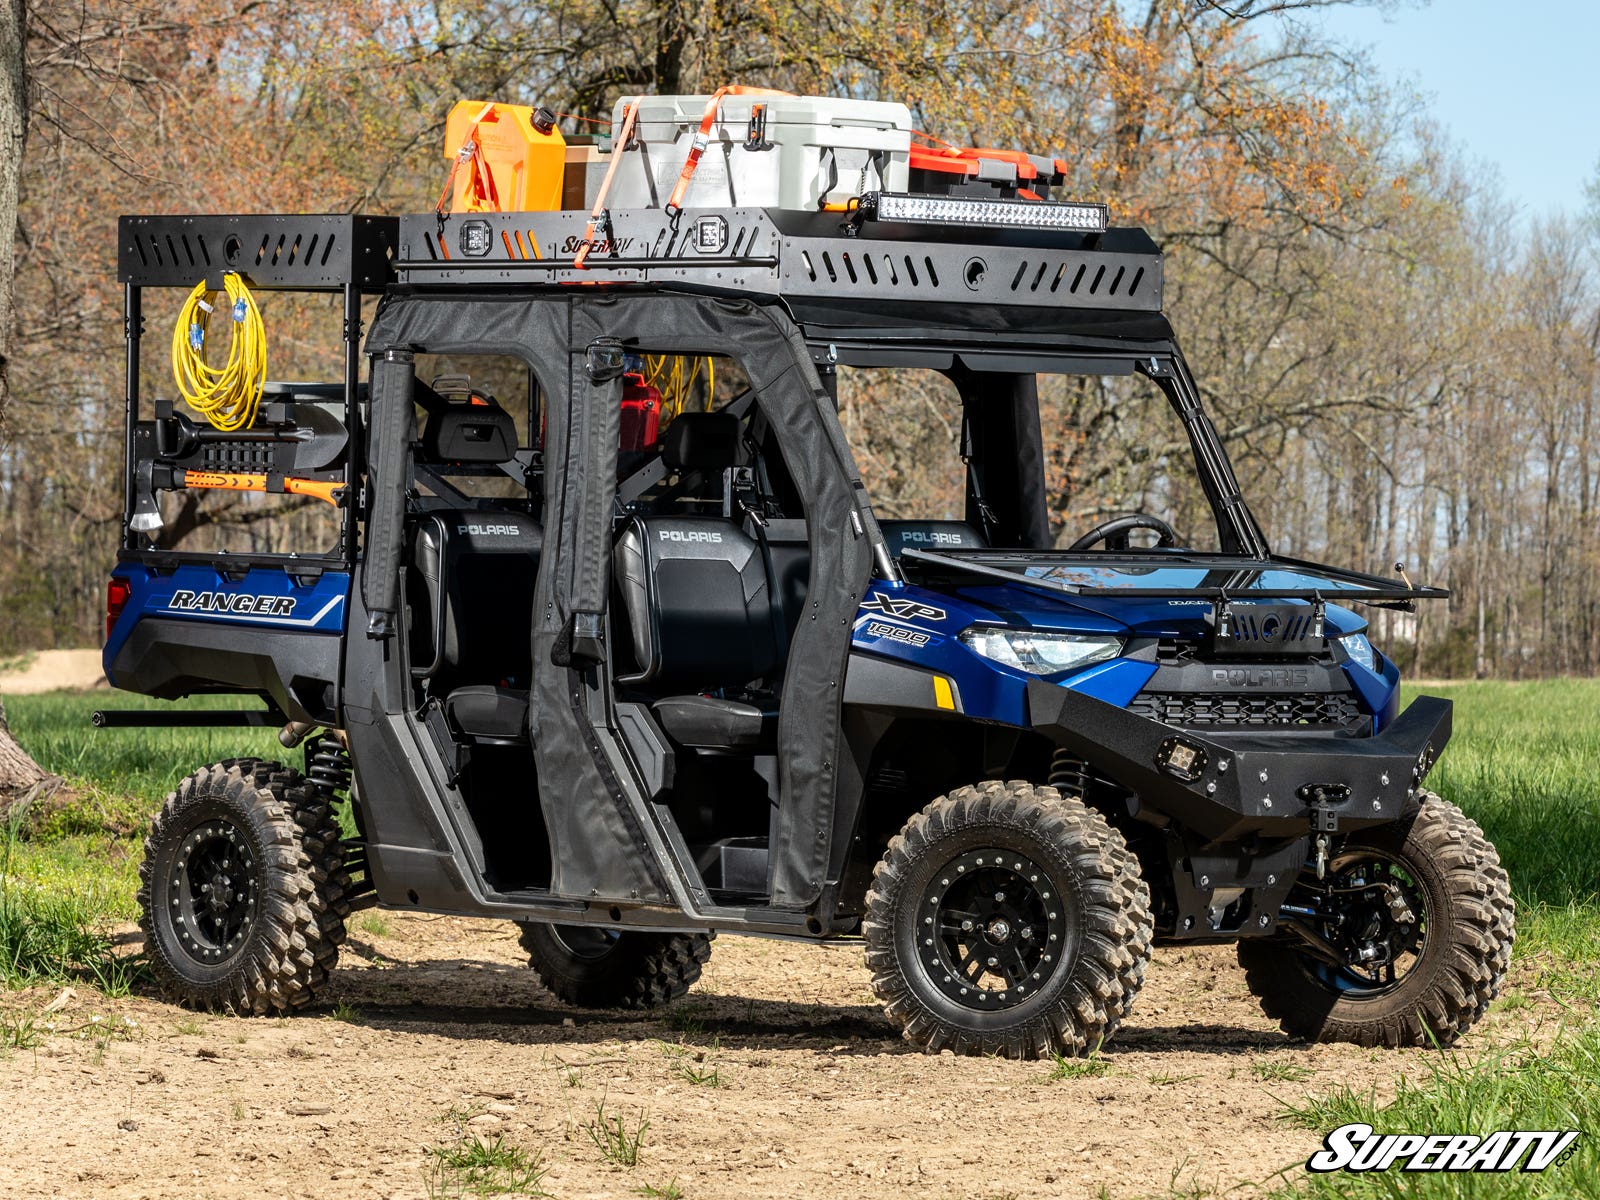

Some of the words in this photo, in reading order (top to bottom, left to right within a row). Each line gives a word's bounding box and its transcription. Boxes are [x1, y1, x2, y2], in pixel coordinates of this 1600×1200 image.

[457, 525, 519, 535] POLARIS
[659, 531, 722, 543] POLARIS
[901, 532, 961, 544] POLARIS
[168, 590, 296, 616] RANGER
[859, 591, 946, 620] XP
[867, 621, 930, 645] 1000
[1212, 669, 1308, 687] POLARIS
